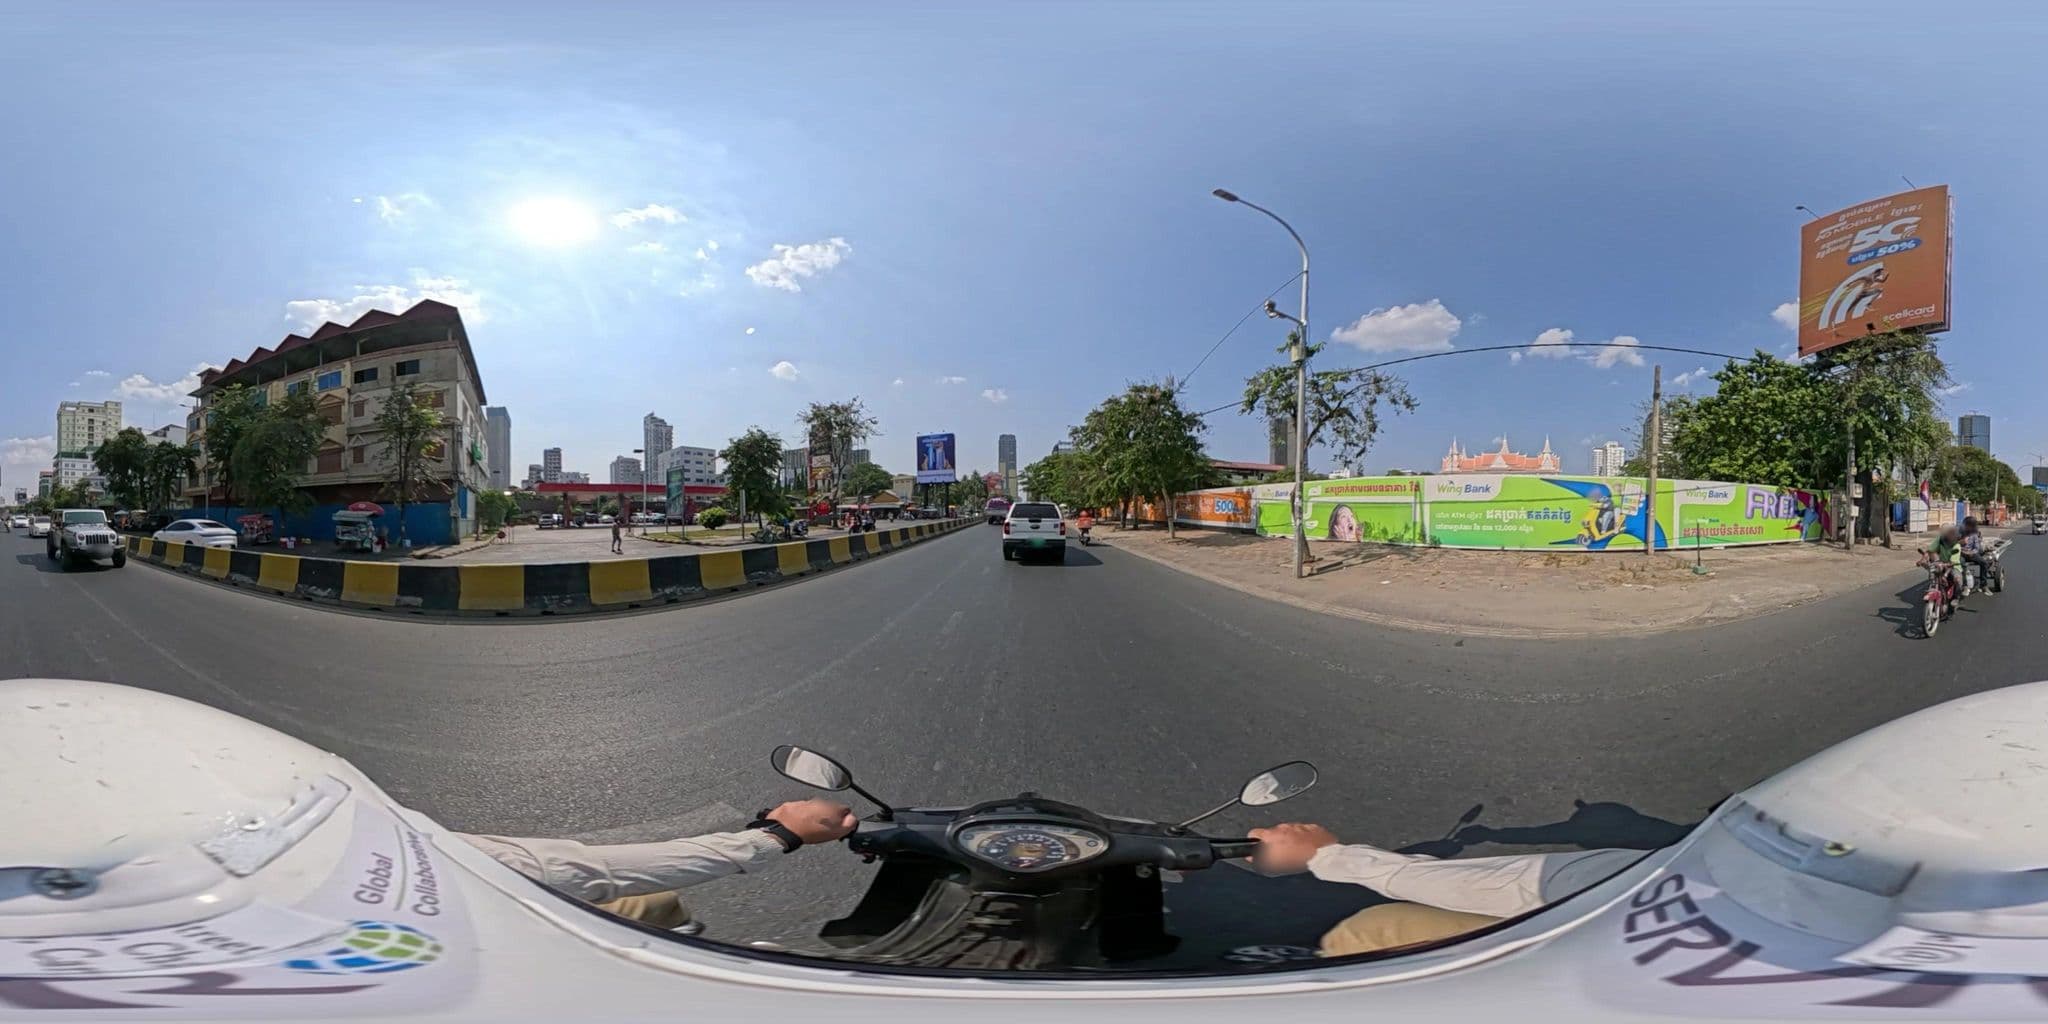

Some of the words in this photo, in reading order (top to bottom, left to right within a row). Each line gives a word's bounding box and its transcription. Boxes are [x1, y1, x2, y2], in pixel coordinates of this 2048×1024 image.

[1876, 240, 1917, 258] 50%
[1889, 304, 1935, 320] cellcard
[1437, 483, 1462, 495] Wing
[1464, 484, 1491, 493] Bank
[1708, 490, 1729, 498] Bank
[353, 852, 393, 905] Global
